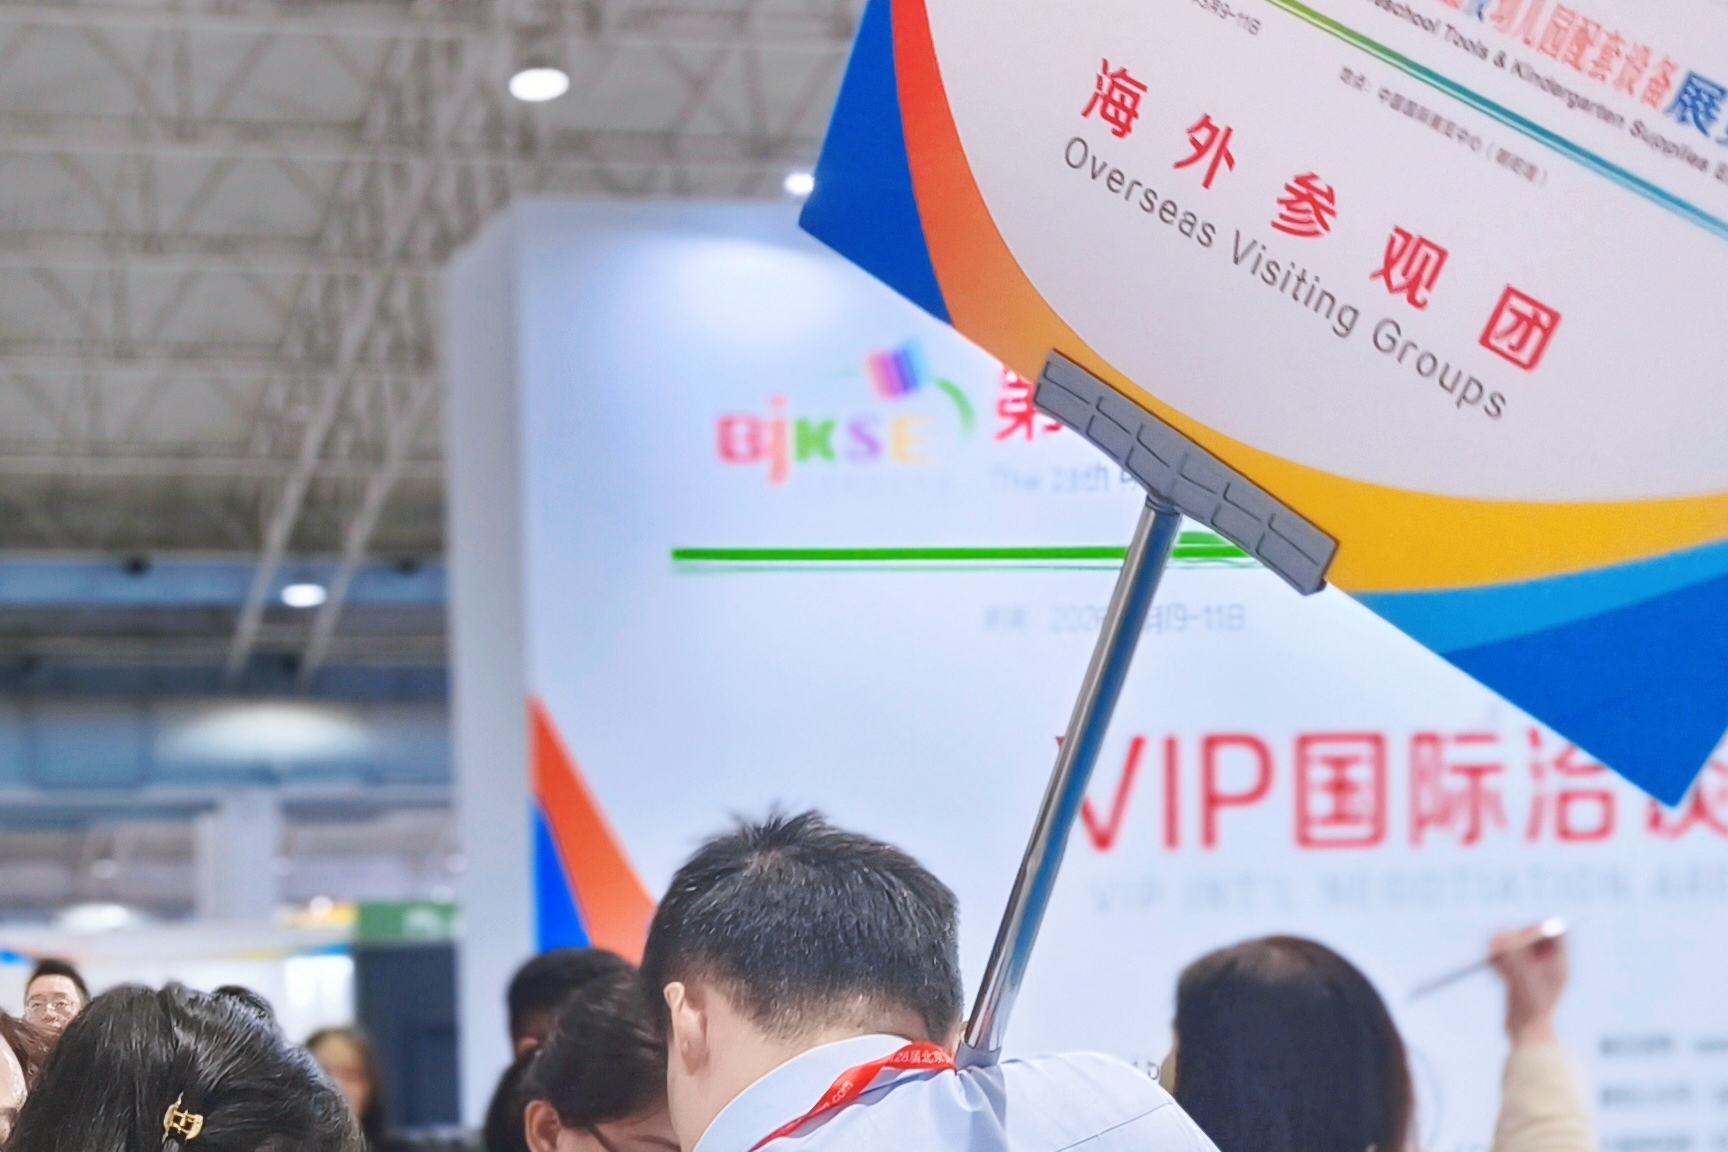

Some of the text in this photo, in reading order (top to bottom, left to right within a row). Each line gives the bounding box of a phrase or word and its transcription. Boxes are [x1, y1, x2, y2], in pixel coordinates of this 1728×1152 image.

[1493, 49, 1507, 69] &
[1063, 135, 1510, 421] Overseas Visiting Groups
[1081, 57, 1562, 373] 海外参观团
